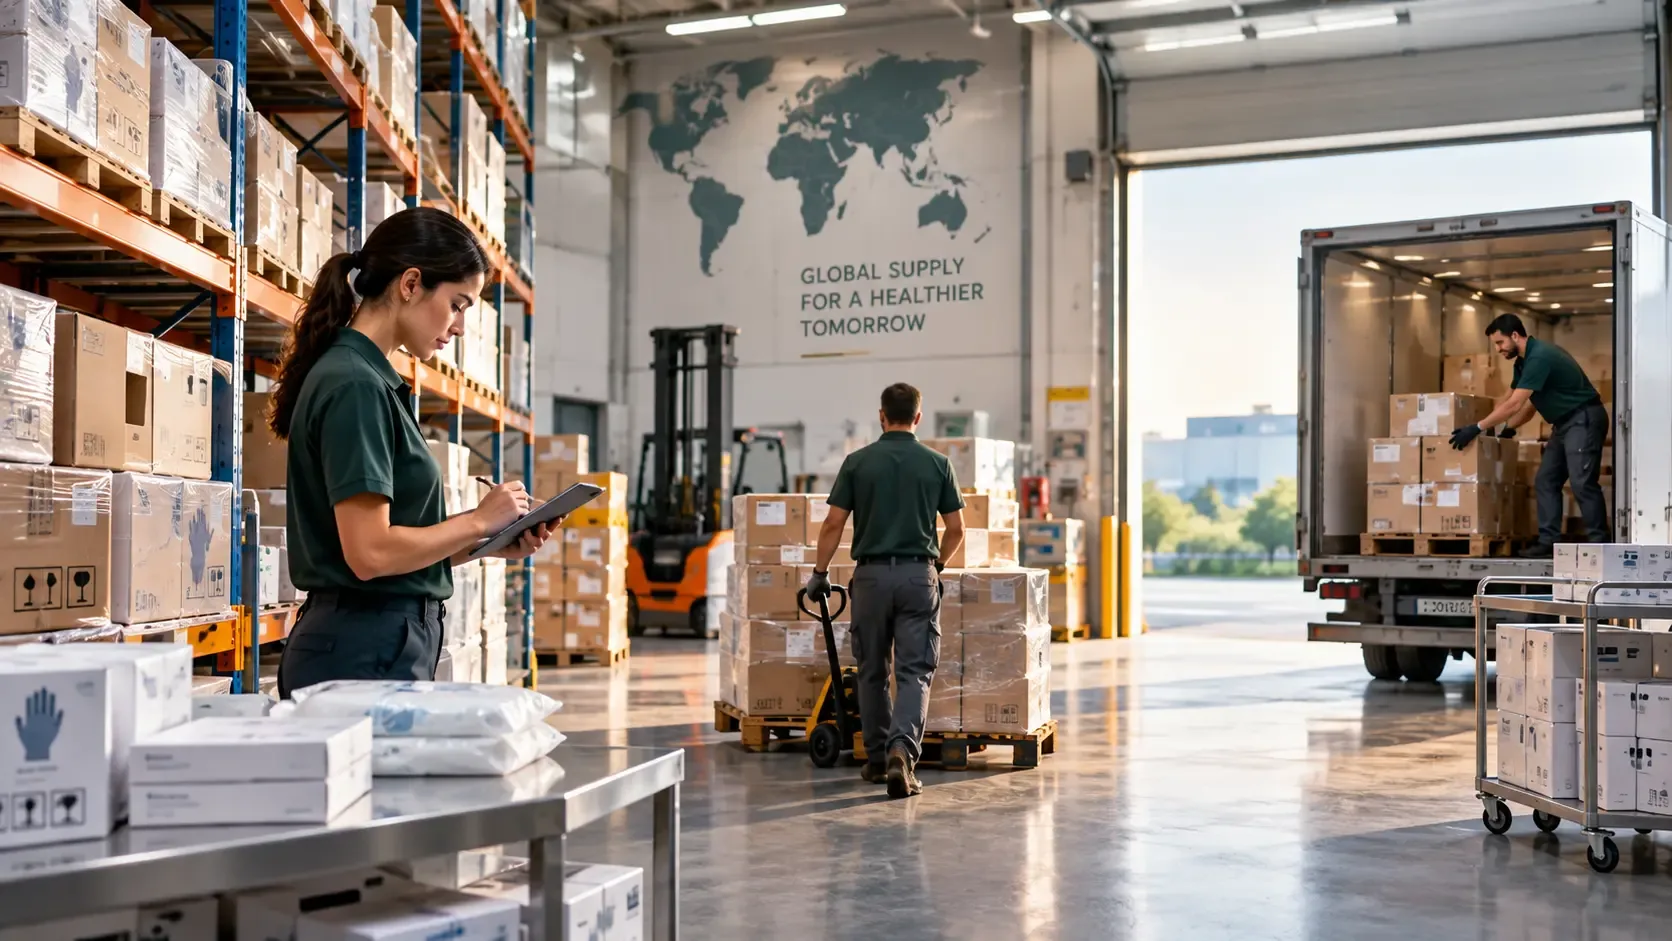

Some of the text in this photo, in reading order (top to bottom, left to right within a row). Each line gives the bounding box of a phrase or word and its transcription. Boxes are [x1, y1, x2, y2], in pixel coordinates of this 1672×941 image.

[801, 257, 964, 284] GLOBAL SUPPLY
[801, 283, 984, 311] FOR A HEALTHIER
[800, 313, 926, 337] TOMORROW
